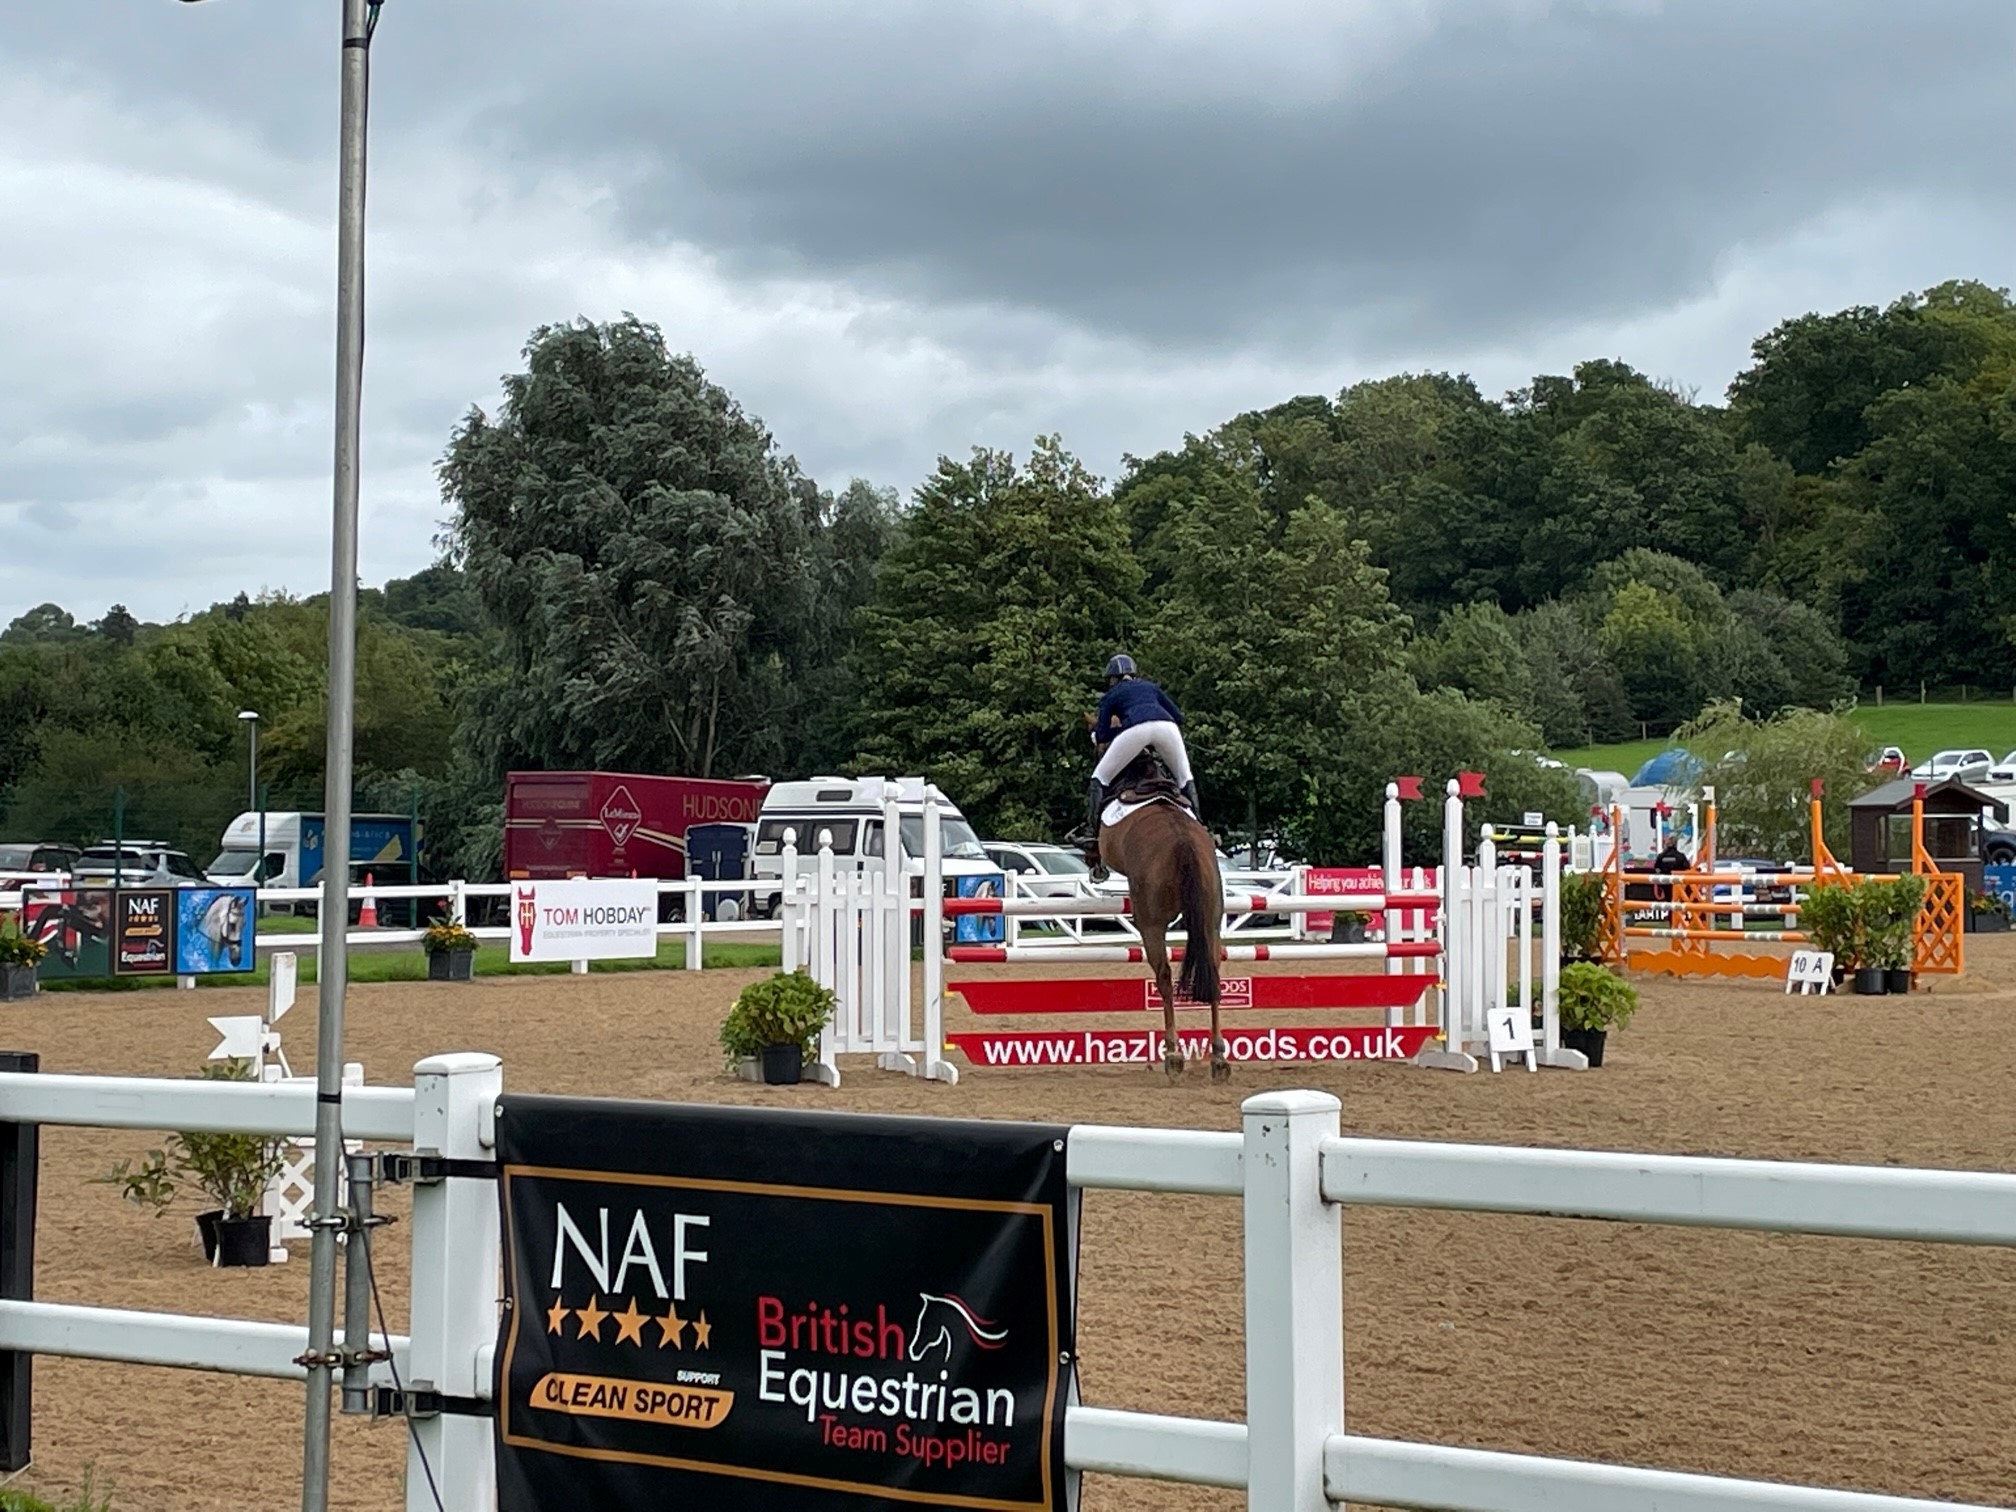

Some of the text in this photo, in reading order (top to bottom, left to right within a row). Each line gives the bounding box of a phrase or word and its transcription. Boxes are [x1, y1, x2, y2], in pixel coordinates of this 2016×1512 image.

[1309, 873, 1340, 893] Helping
[1340, 878, 1358, 892] you
[1359, 873, 1384, 889] achiev
[128, 898, 159, 914] NAF
[543, 906, 645, 925] TOM HOBDAY
[1795, 957, 1823, 974] 10 A
[1503, 1018, 1515, 1040] 1
[551, 1202, 710, 1301] NAF
[757, 1296, 905, 1360] British
[677, 1369, 721, 1385] SUPPORT
[759, 1349, 1015, 1427] Equestrian
[546, 1378, 720, 1421] CLEAN SPORT
[819, 1413, 1011, 1469] Team Supplier
